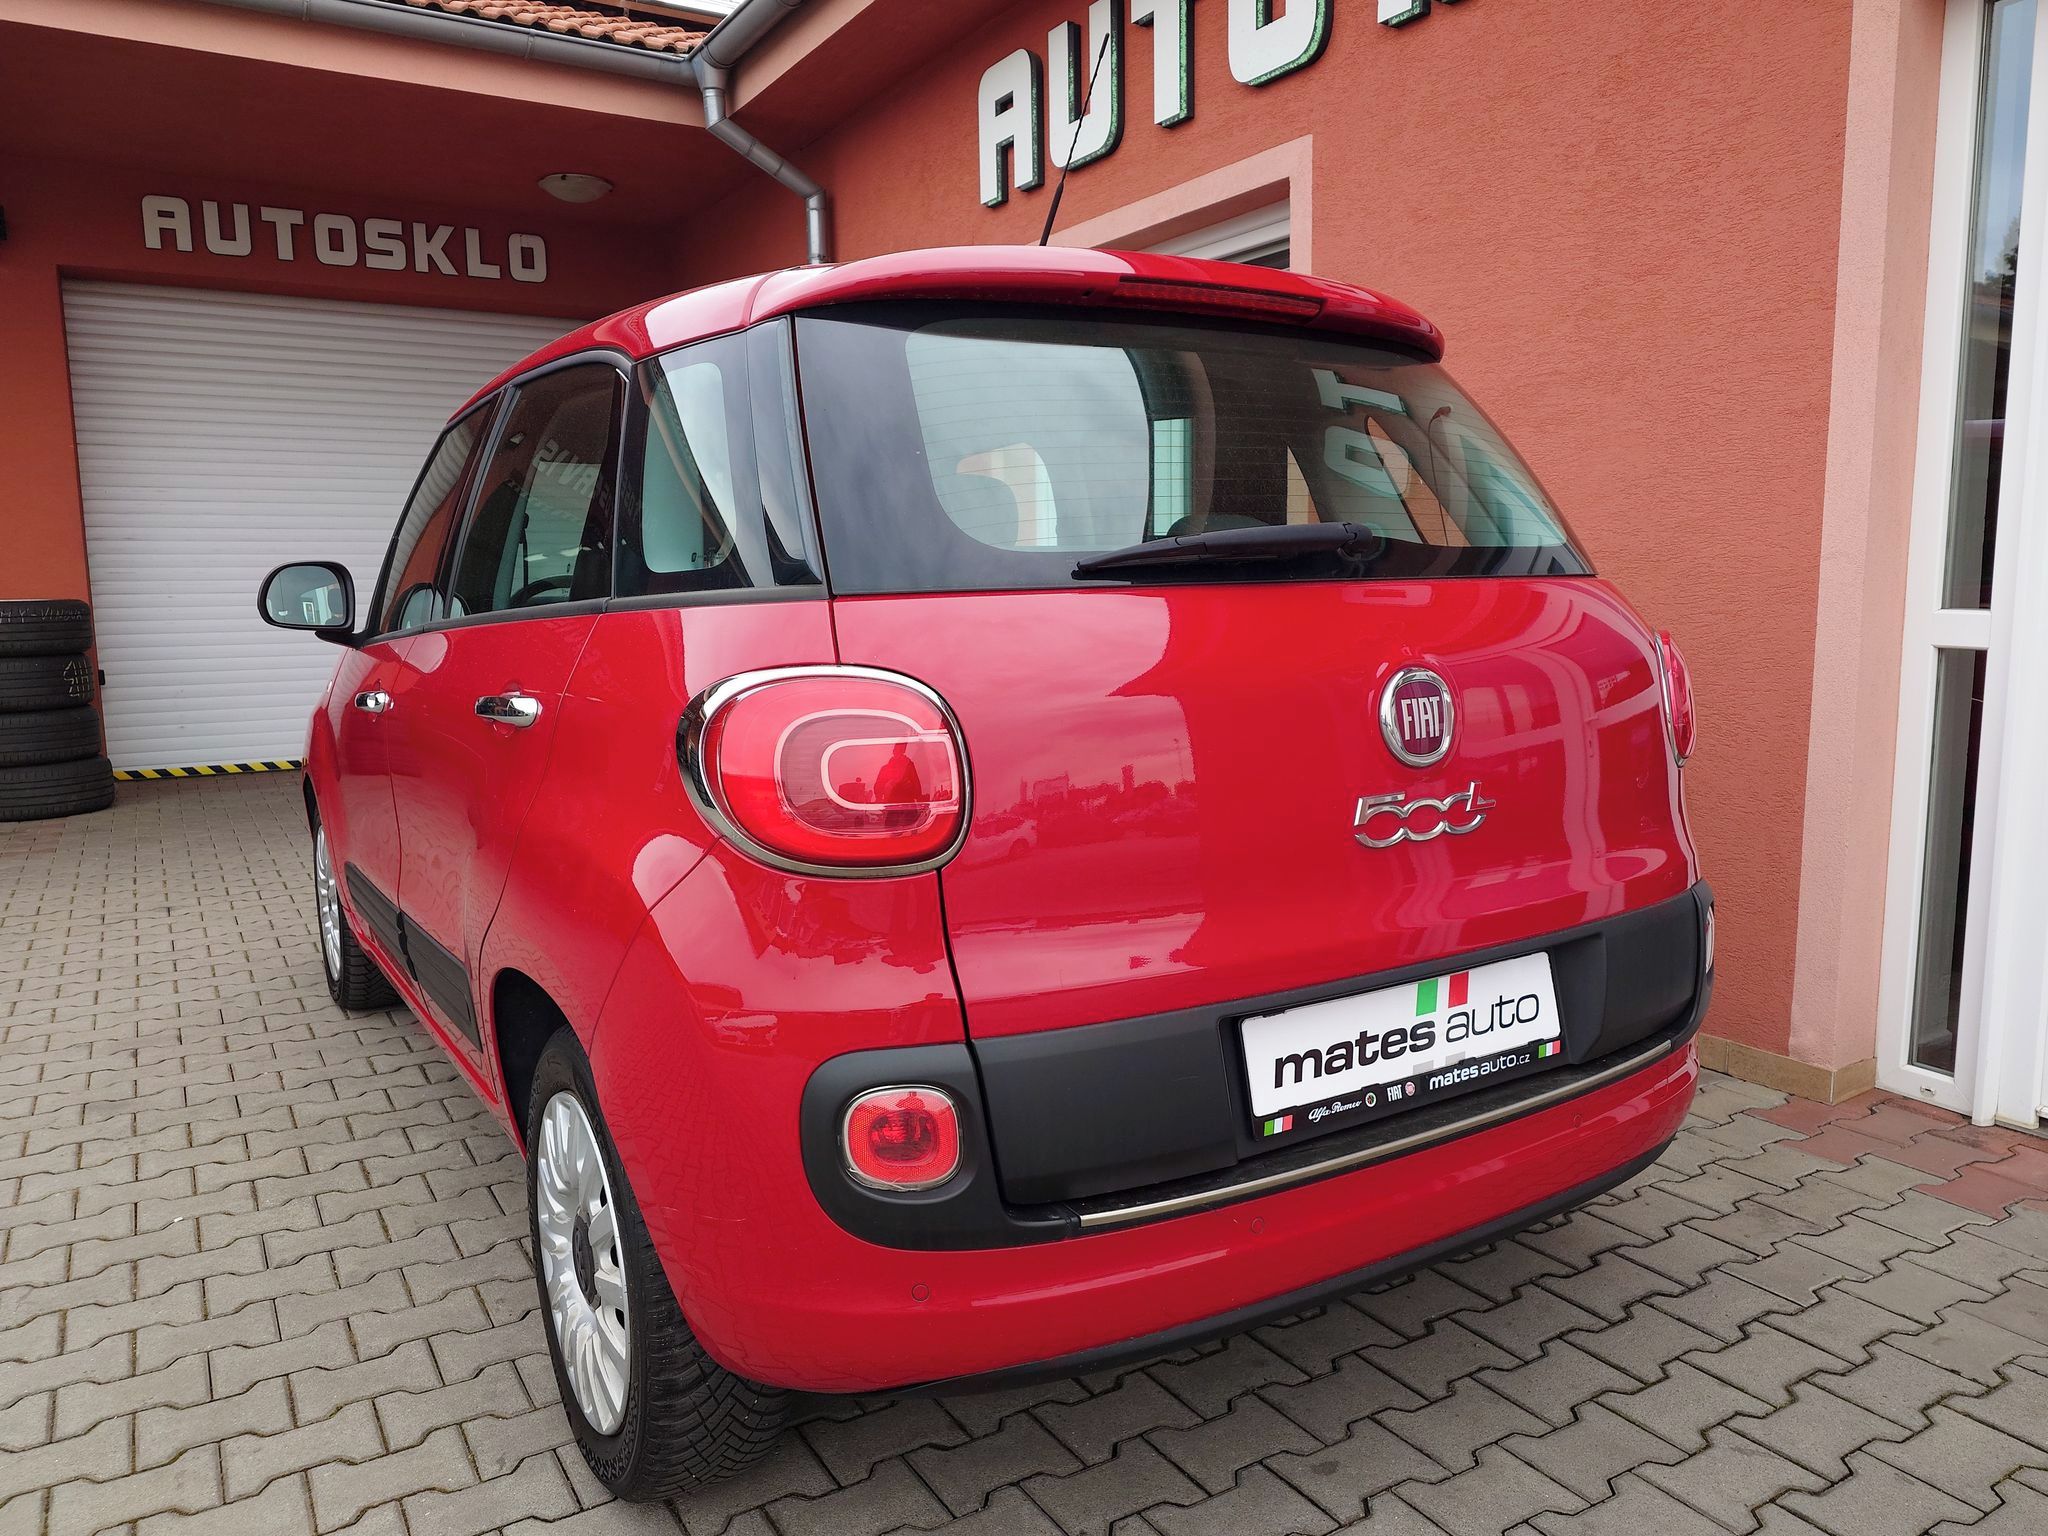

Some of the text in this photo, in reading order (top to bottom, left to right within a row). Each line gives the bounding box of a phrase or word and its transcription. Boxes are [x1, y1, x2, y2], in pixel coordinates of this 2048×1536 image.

[141, 194, 548, 284] AUTOSKLO
[1401, 696, 1441, 741] FIAT
[1274, 993, 1540, 1089] mates auto
[1387, 1084, 1403, 1102] FIAT
